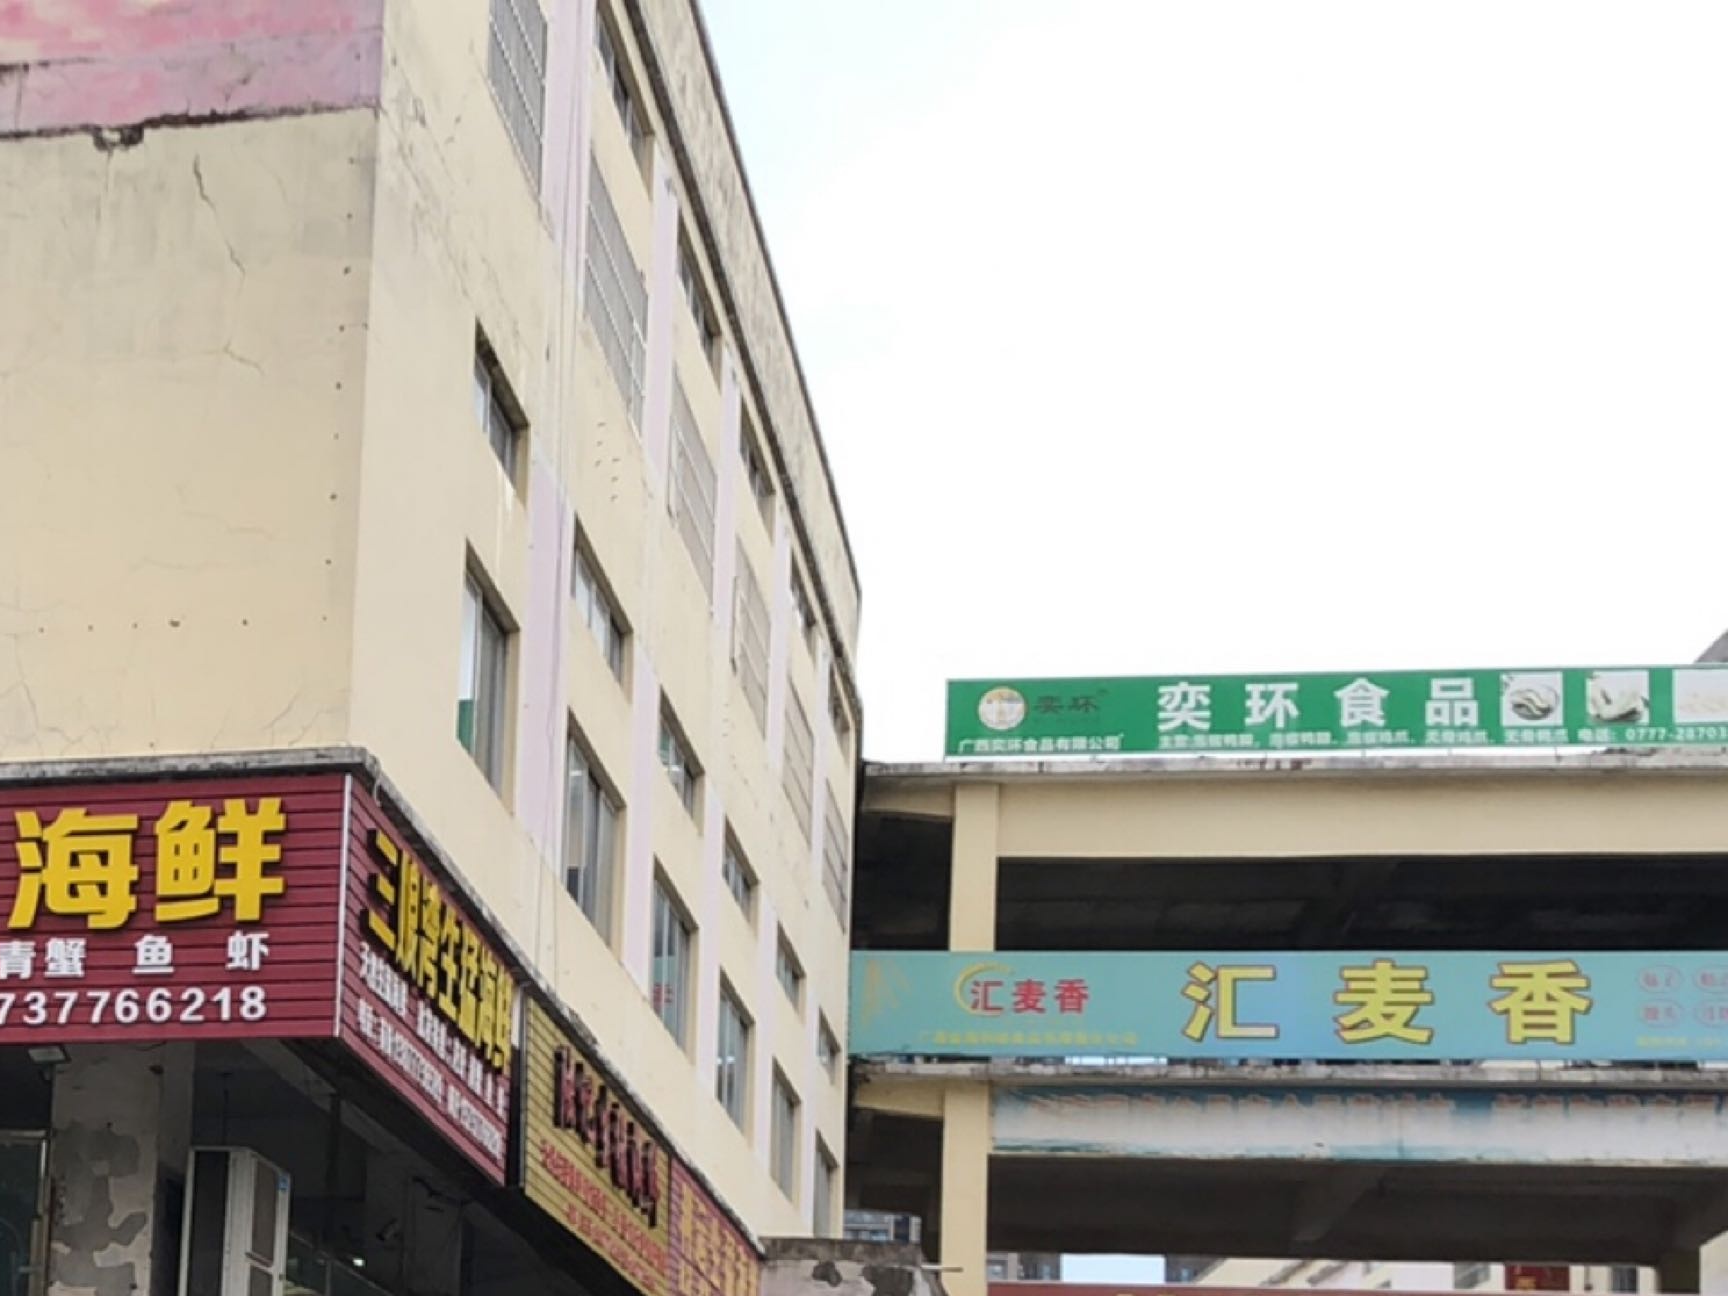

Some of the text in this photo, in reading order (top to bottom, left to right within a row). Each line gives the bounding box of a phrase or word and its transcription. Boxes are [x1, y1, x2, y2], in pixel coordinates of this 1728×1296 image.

[1158, 677, 1478, 732] 奕环食品
[132, 935, 175, 974] 鱼
[227, 931, 269, 971] 虾
[970, 977, 1090, 1015] 汇麦香
[1180, 959, 1593, 1046] 汇麦香
